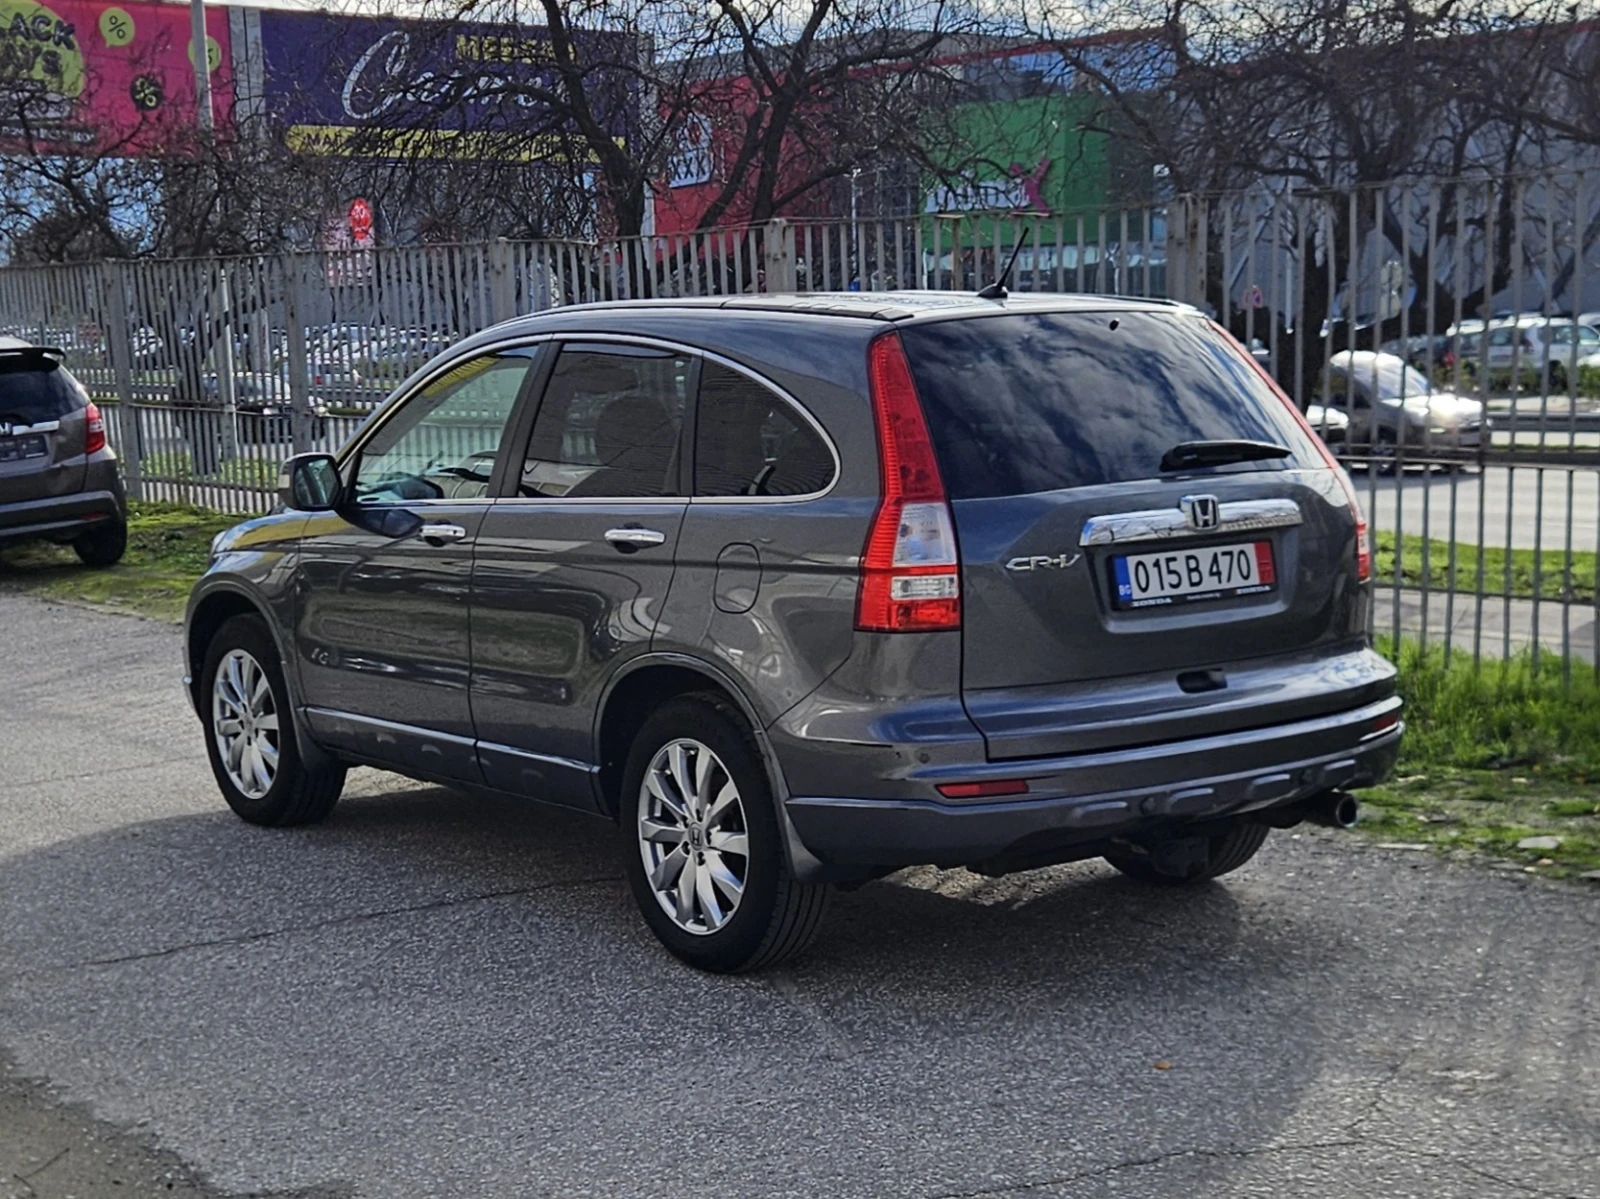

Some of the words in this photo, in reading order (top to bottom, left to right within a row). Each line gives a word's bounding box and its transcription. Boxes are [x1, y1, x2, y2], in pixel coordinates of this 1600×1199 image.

[0, 12, 75, 50] ACK
[1005, 554, 1081, 571] CR-V
[1134, 549, 1250, 593] 015B470
